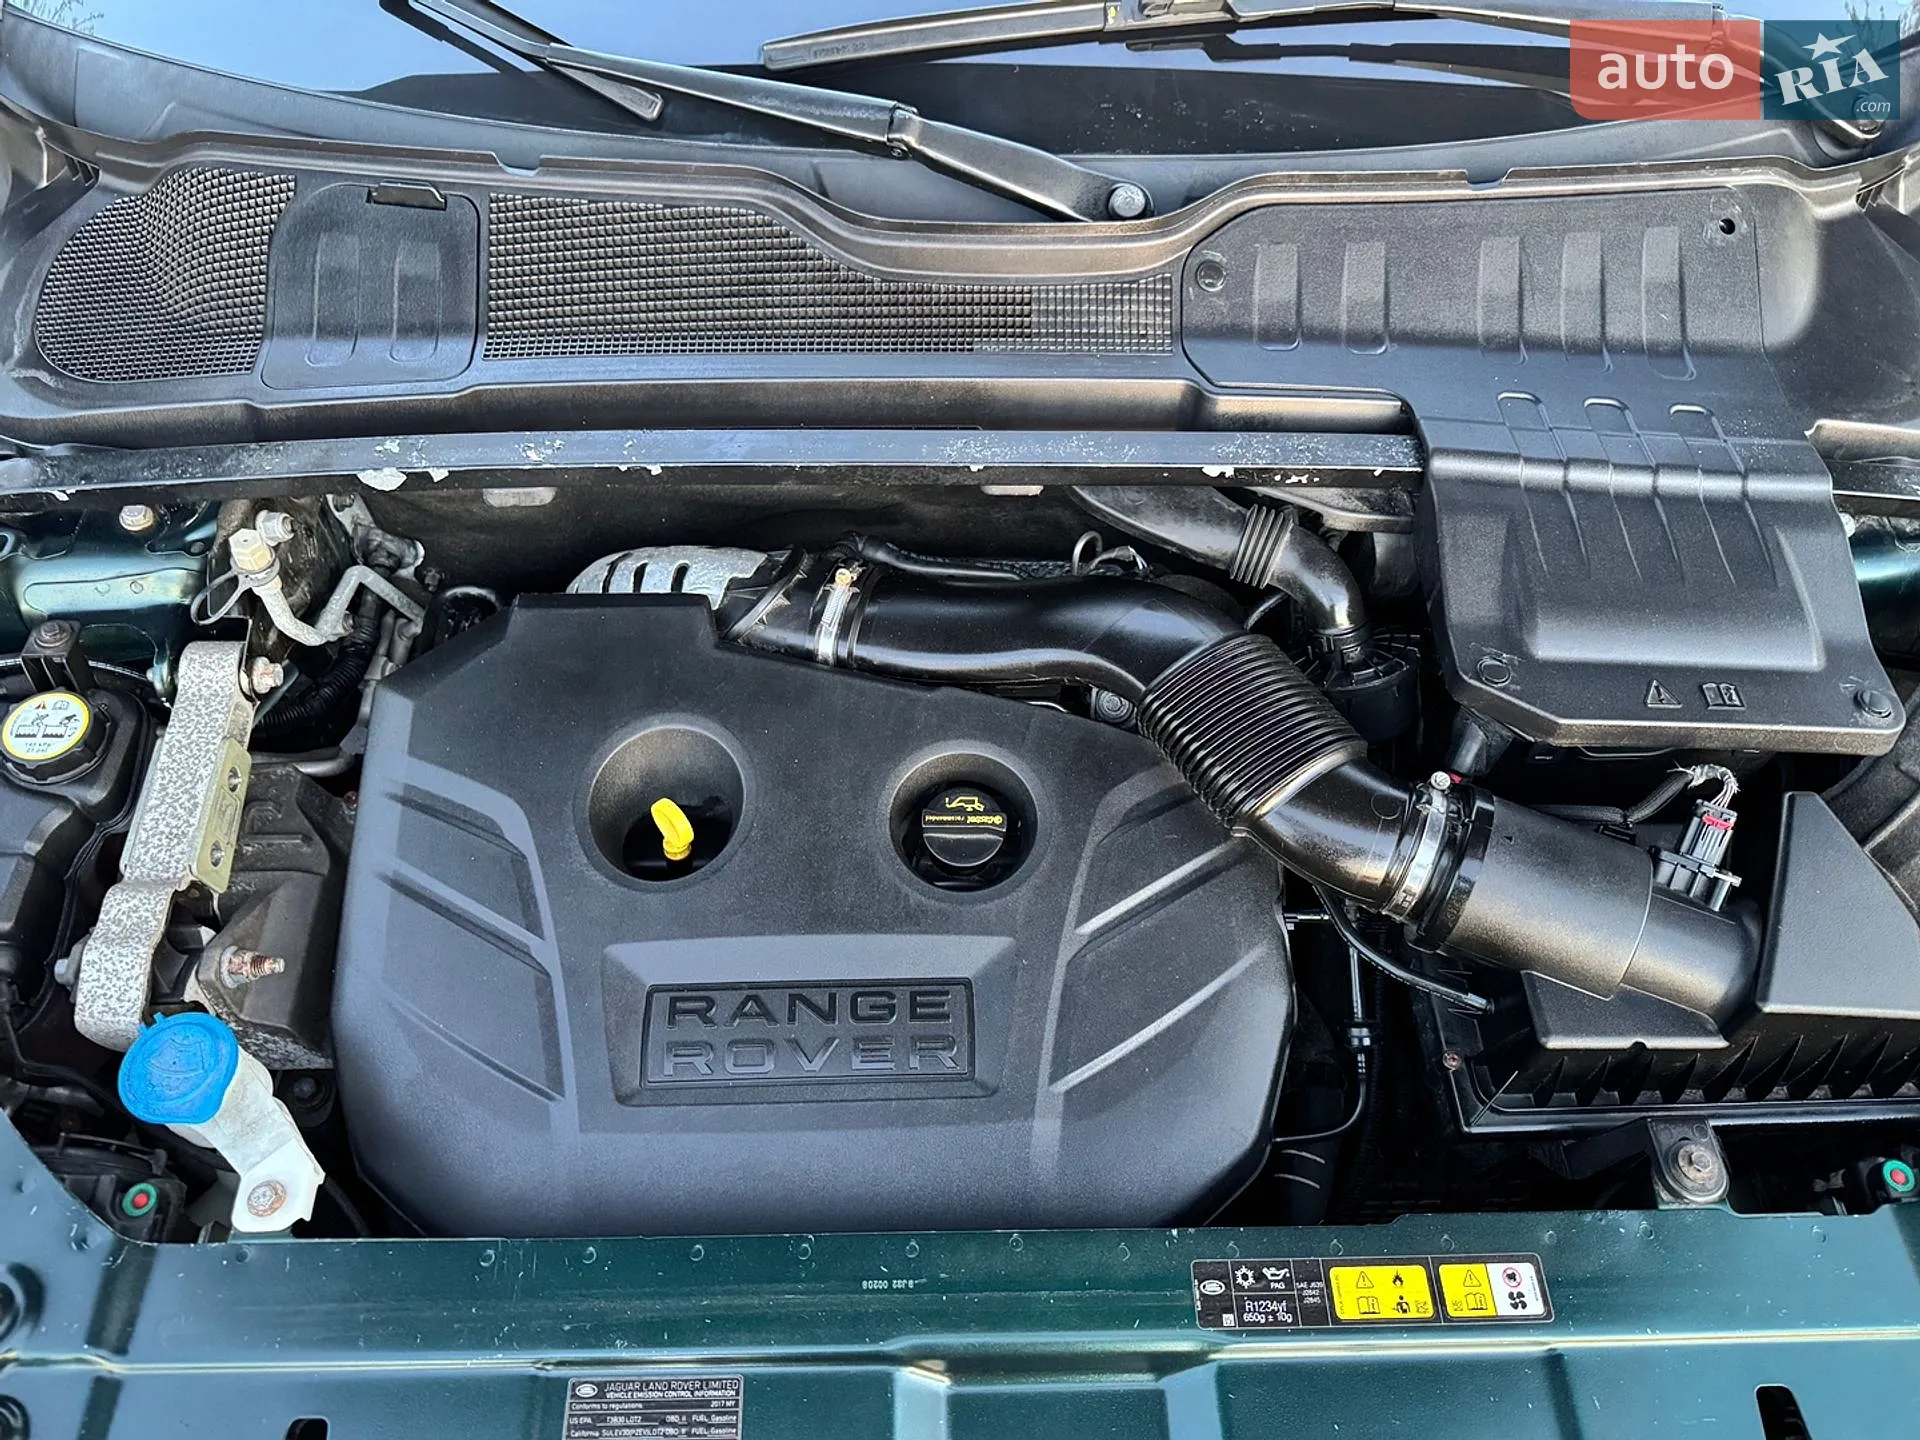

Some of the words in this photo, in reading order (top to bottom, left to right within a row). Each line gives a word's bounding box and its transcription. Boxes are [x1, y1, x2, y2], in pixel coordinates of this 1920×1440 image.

[667, 990, 952, 1030] RANGE
[663, 1033, 960, 1078] ROVER
[1245, 1301, 1287, 1312] R1234yf
[1243, 1313, 1266, 1323] 650g
[1276, 1312, 1292, 1323] 10g
[604, 1382, 640, 1391] JAGUAR
[643, 1381, 667, 1391] LAND
[671, 1380, 700, 1390] ROVER
[703, 1380, 738, 1389] LIMITED
[694, 1389, 736, 1397] INFORMATION
[571, 1402, 600, 1410] Conforms
[609, 1403, 643, 1411] regulations
[710, 1414, 737, 1422] Gasoline
